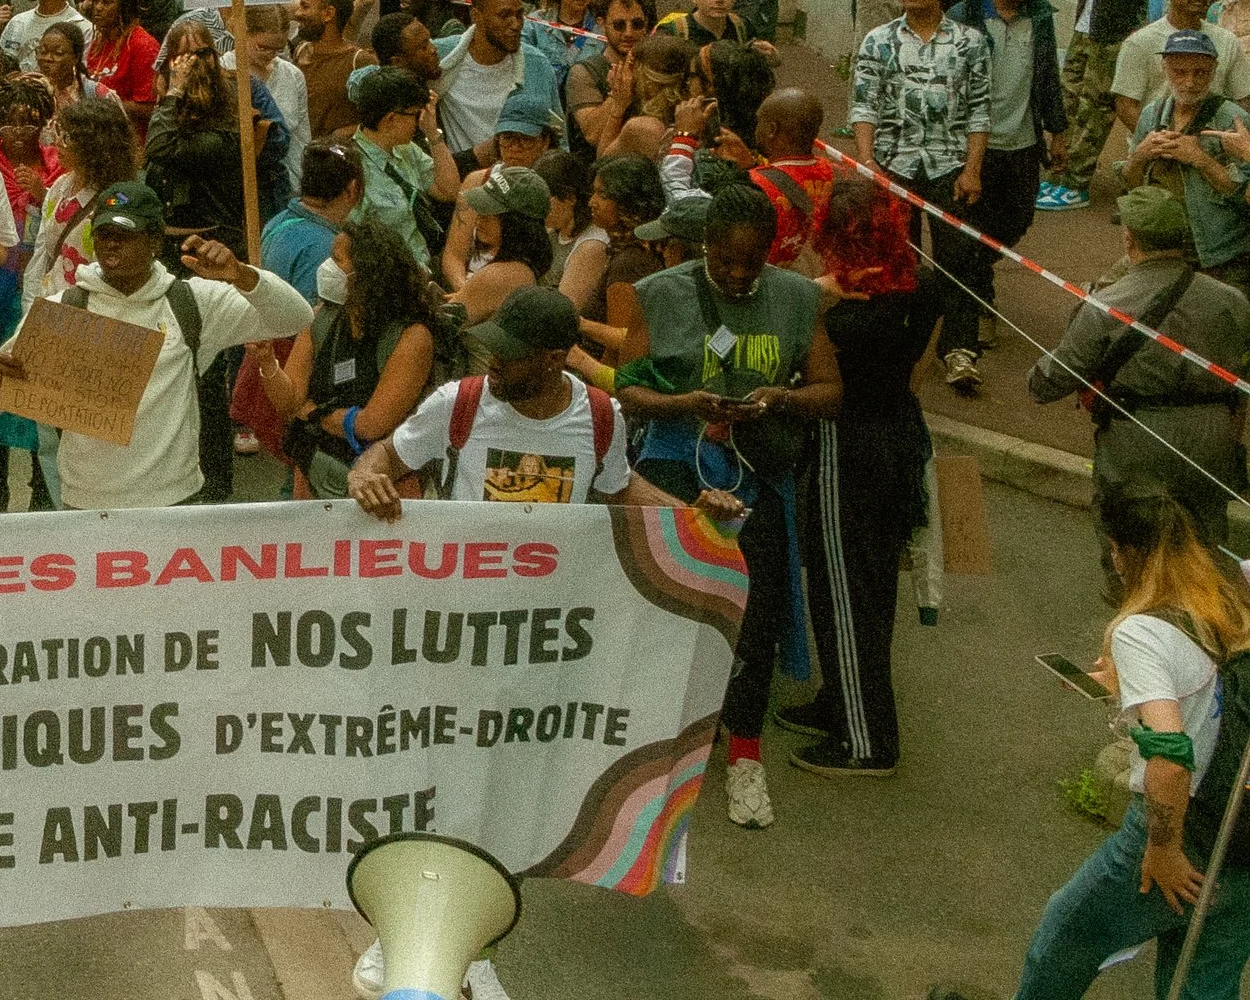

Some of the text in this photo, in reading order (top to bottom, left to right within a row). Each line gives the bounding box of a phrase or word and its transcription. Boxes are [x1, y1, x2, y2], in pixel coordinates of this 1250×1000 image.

[95, 540, 559, 589] BANLIEUES
[165, 630, 219, 671] DE
[252, 610, 373, 670] NOS
[391, 606, 595, 665] LUTTES
[216, 701, 630, 757] D'EXTRÊME-DROITE
[39, 786, 437, 863] ANTI-RACISTE
